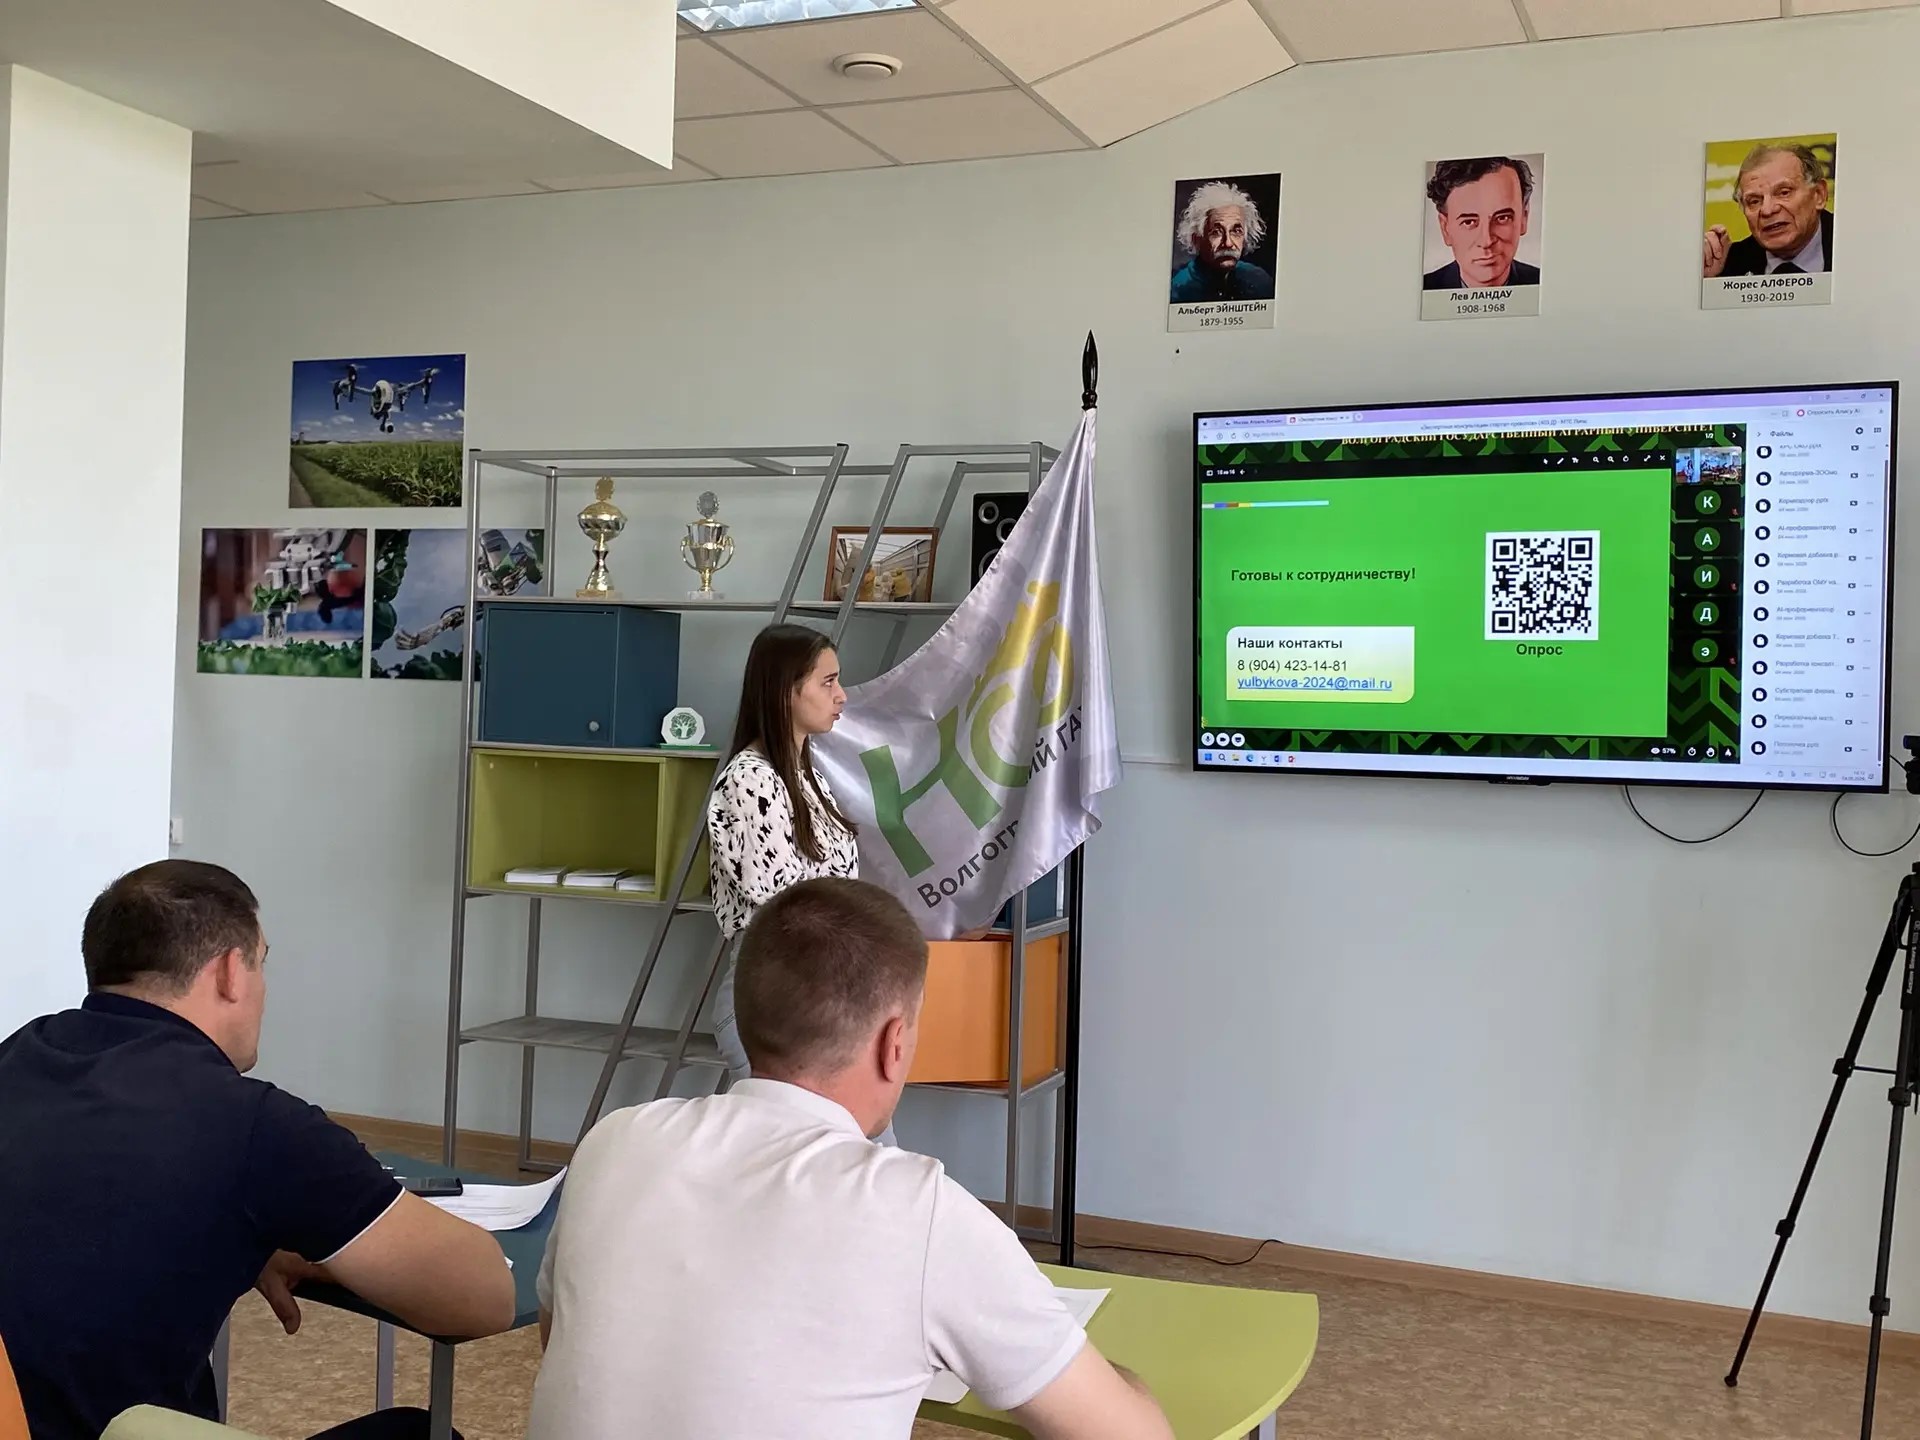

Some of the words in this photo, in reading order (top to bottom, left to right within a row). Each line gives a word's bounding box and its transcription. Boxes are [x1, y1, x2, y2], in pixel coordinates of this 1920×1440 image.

[1723, 281, 1758, 291] Жорес
[1760, 277, 1814, 288] АЛФЕРОВ
[1450, 292, 1468, 301] Лев
[1471, 290, 1513, 300] ЛАНДАУ
[1741, 292, 1795, 303] 1930-2019
[1178, 306, 1214, 316] Альберт
[1216, 302, 1267, 313] ЭЙНШТЕЙН
[1456, 303, 1506, 314] 1908-1968
[1200, 317, 1244, 327] 1879-1955
[1703, 497, 1713, 508] К
[1702, 534, 1713, 545] А
[1231, 569, 1283, 582] Готовы
[1286, 571, 1294, 580] к
[1297, 568, 1416, 584] сотрудничеству!
[1701, 571, 1712, 582] И
[1700, 608, 1712, 621] Д
[1237, 638, 1274, 649] Наши
[1279, 639, 1342, 649] контакты
[1516, 643, 1563, 658] Опрос
[1237, 660, 1245, 671] 8
[1249, 660, 1280, 673] (904)
[1284, 660, 1347, 671] 423-14-81
[1237, 676, 1393, 691] yulbykova-2024@mail.ru
[1056, 704, 1082, 751] ГА
